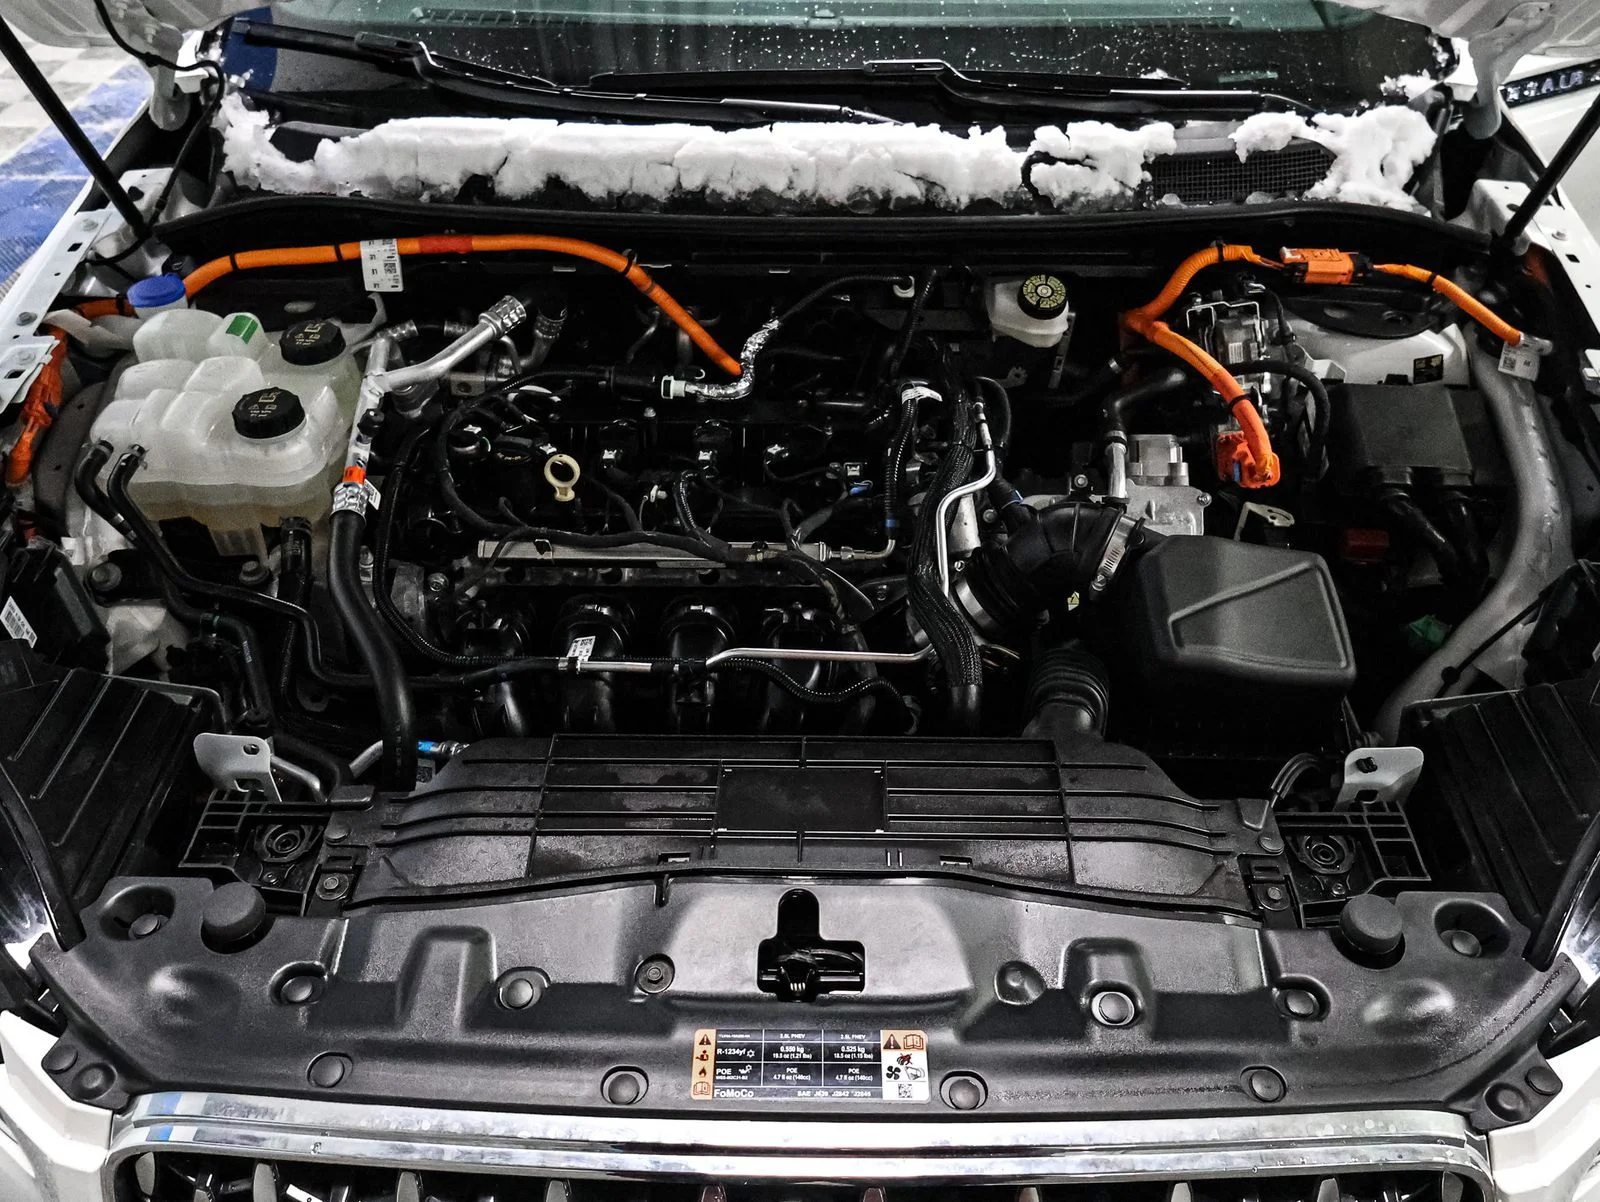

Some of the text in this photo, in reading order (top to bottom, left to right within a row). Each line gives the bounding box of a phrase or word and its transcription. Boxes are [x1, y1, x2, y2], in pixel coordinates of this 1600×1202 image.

[716, 1048, 746, 1056] R-1234yf
[796, 1046, 804, 1054] kg
[858, 1046, 866, 1054] kg
[714, 1089, 754, 1098] FoMoCo
